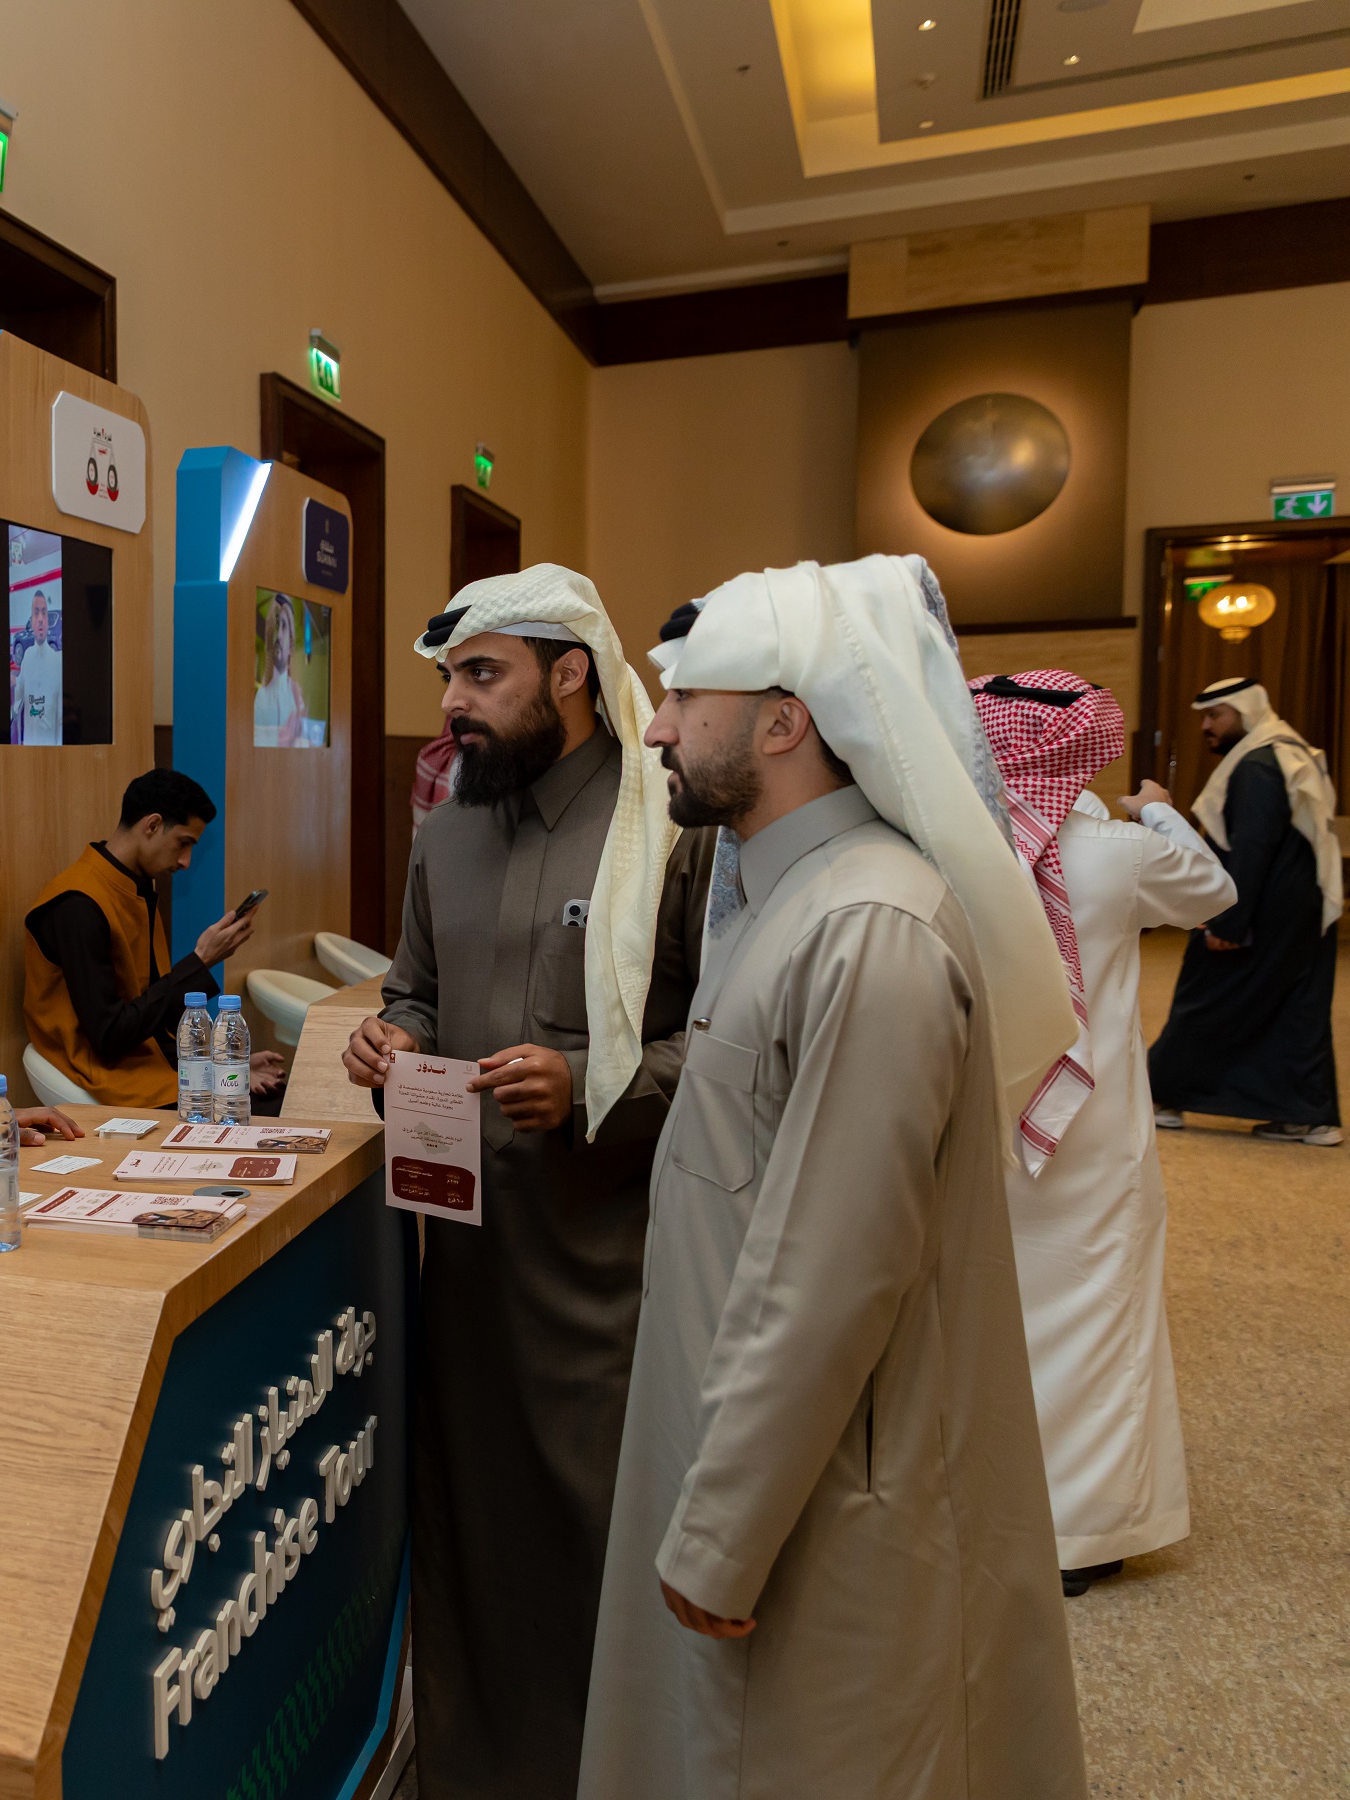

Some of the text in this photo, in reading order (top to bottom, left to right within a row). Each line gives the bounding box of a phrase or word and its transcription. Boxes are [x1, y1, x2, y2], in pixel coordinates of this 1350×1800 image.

[220, 1078, 239, 1088] Nova
[151, 1306, 378, 1633] جولة الامتياز التجاري
[152, 1414, 378, 1760] Franchise Tour
